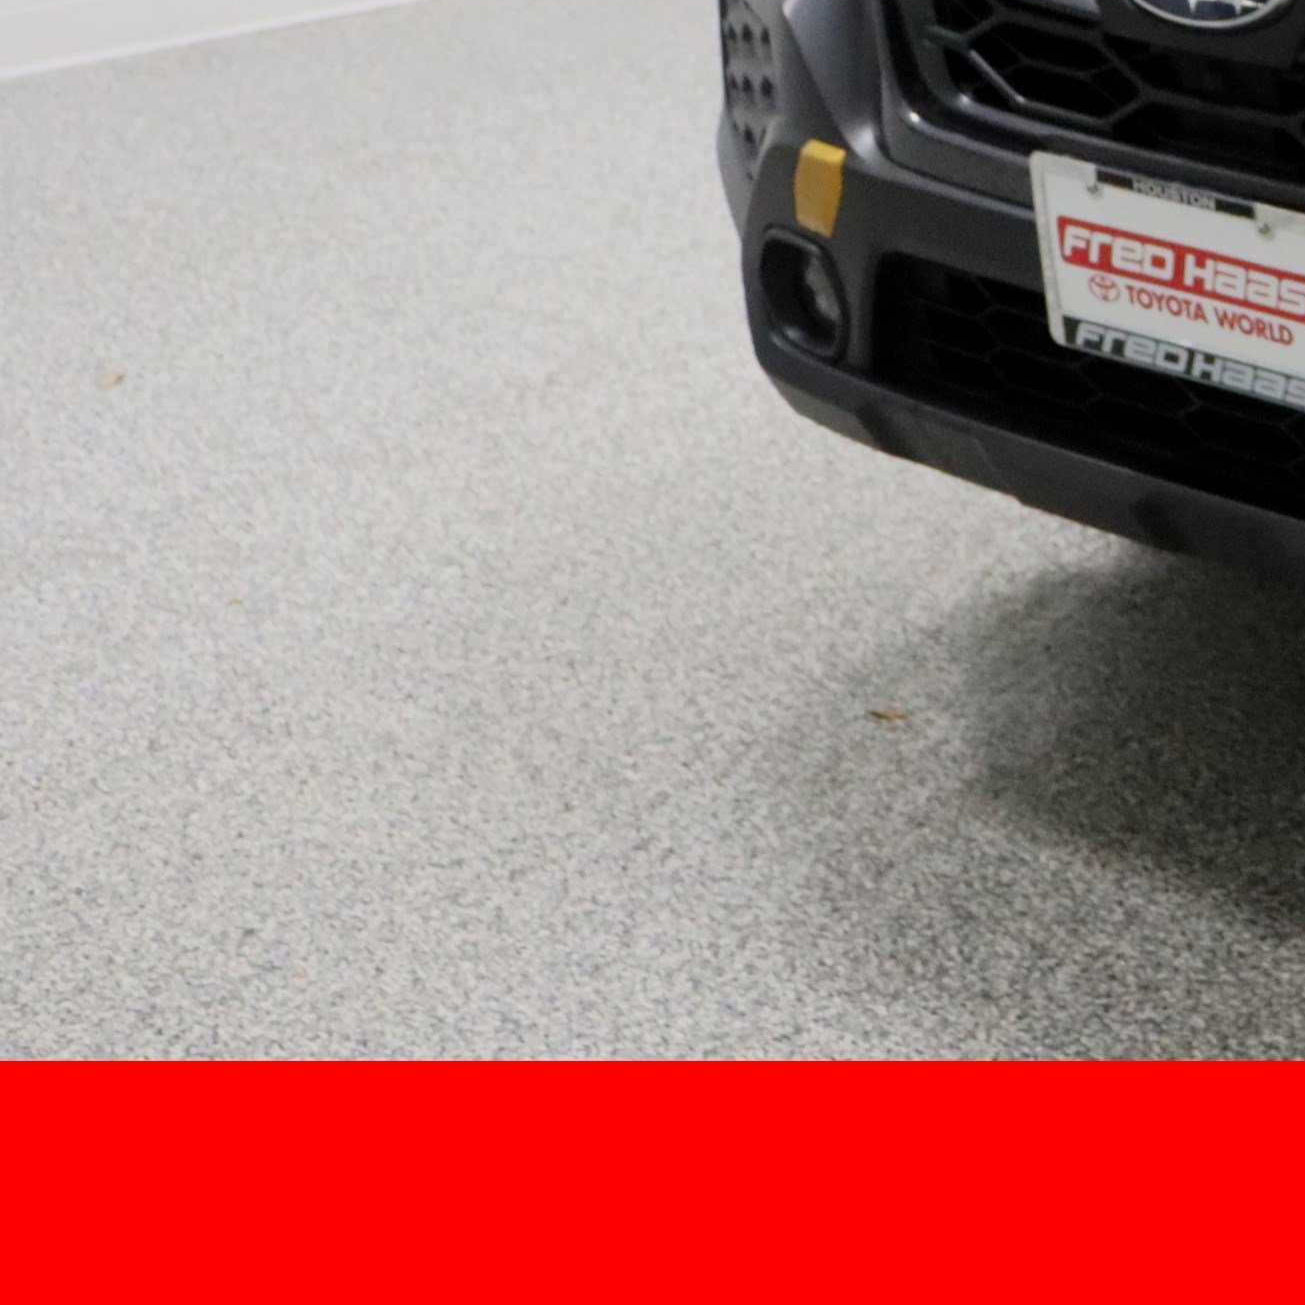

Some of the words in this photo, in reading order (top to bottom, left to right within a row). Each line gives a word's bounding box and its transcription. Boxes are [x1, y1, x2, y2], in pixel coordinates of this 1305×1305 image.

[1133, 177, 1216, 211] HOUSTON
[1125, 284, 1208, 325] TOYOTA
[1213, 307, 1295, 346] WORLD
